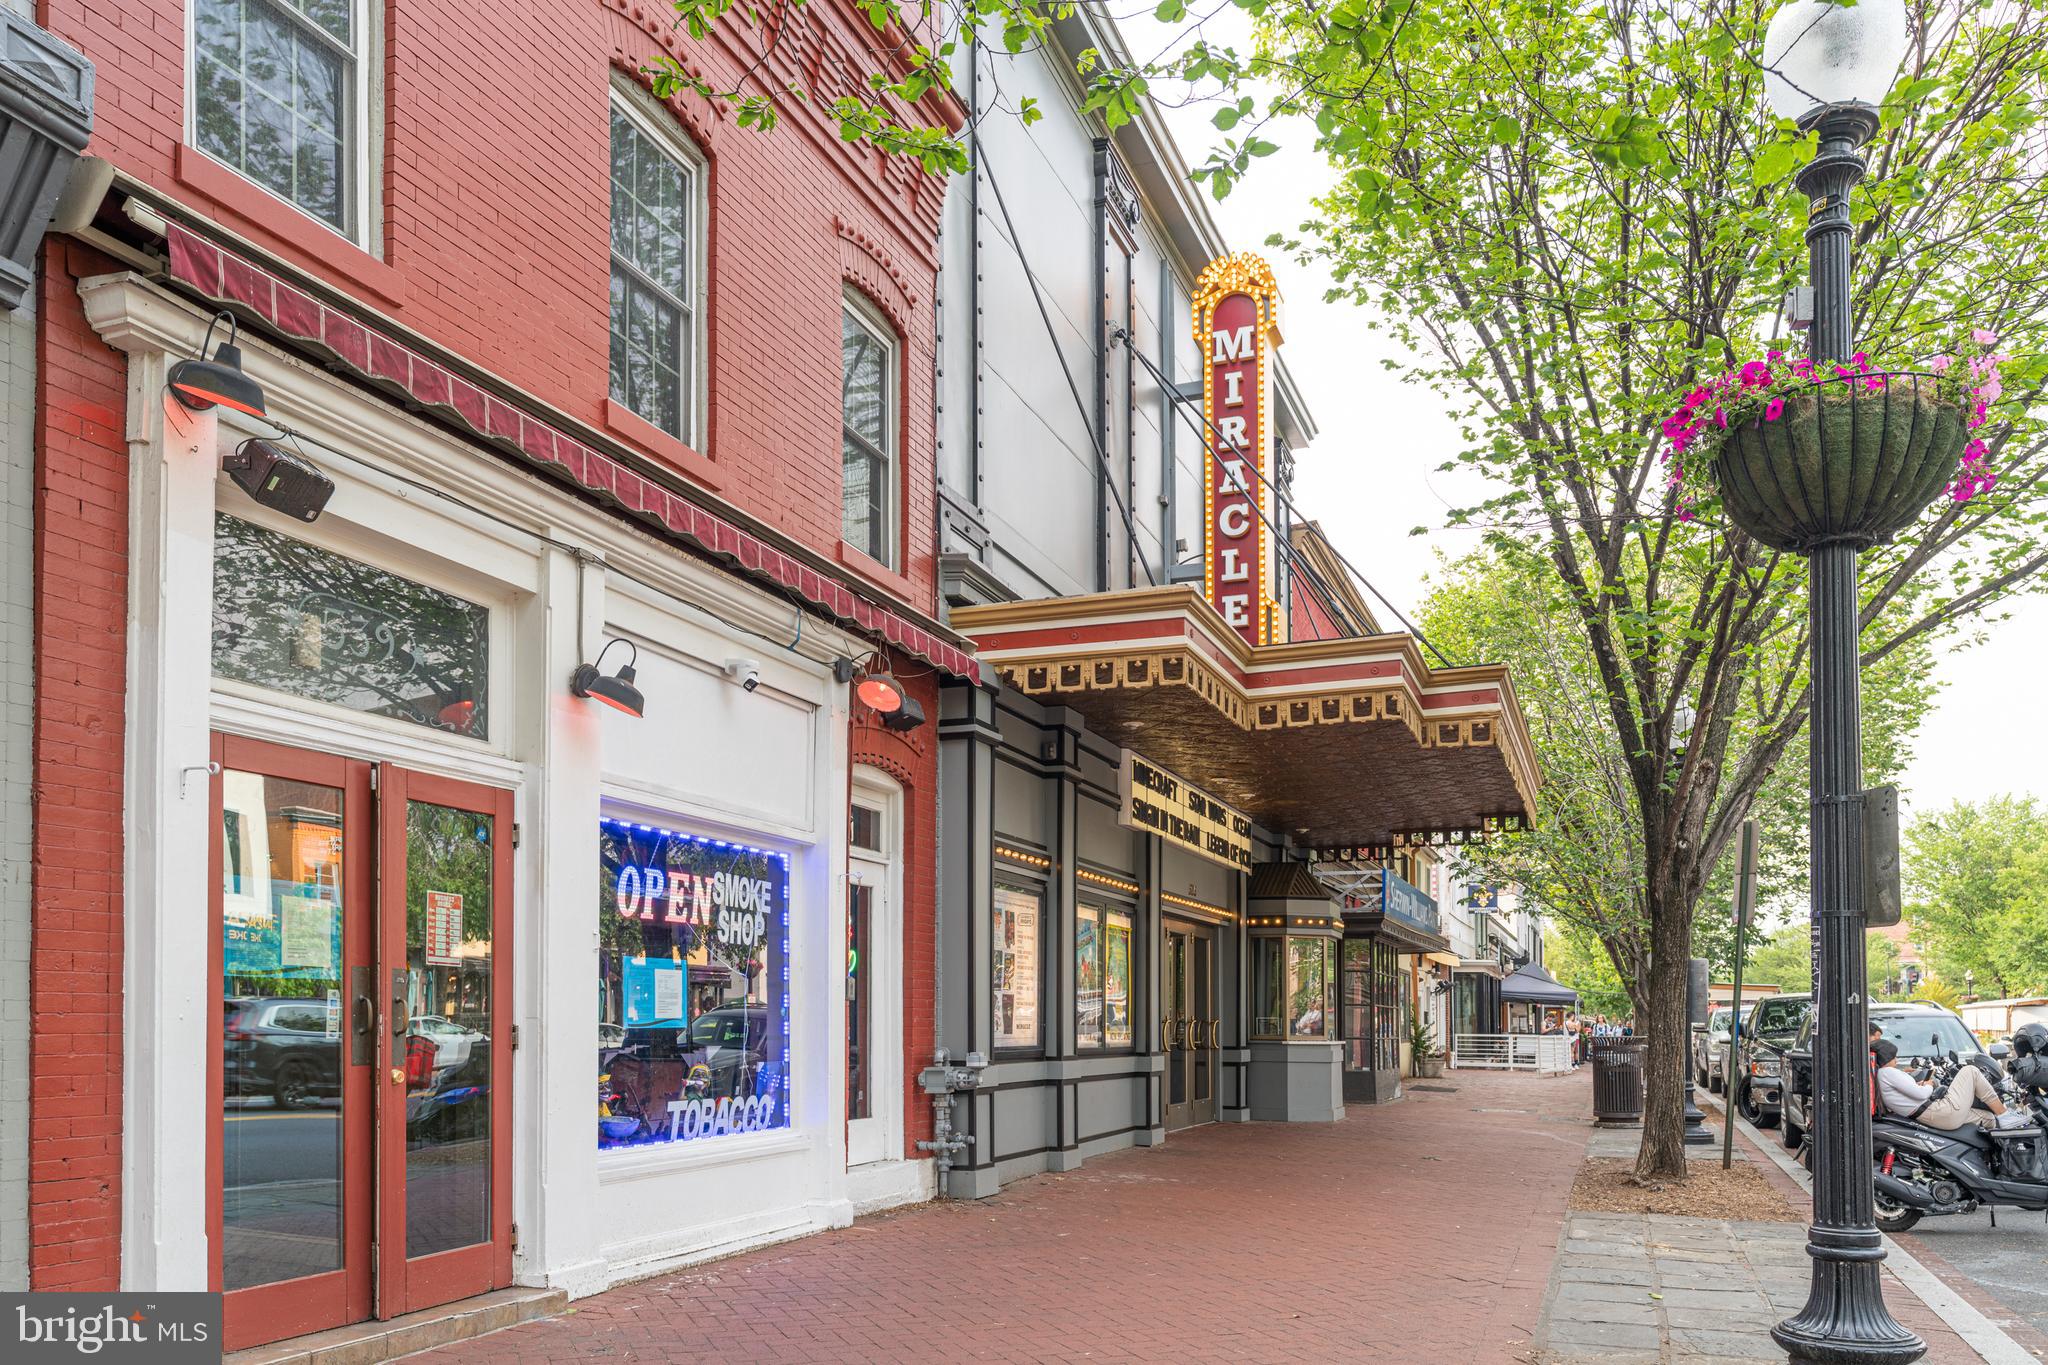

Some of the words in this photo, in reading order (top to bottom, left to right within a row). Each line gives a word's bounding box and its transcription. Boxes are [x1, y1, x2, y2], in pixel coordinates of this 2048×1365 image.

[1212, 325, 1255, 628] MIRACLE
[617, 865, 714, 926] OPEN
[712, 871, 772, 914] SMOKE
[717, 909, 766, 947] SHOP
[667, 1094, 772, 1142] TOBACCO
